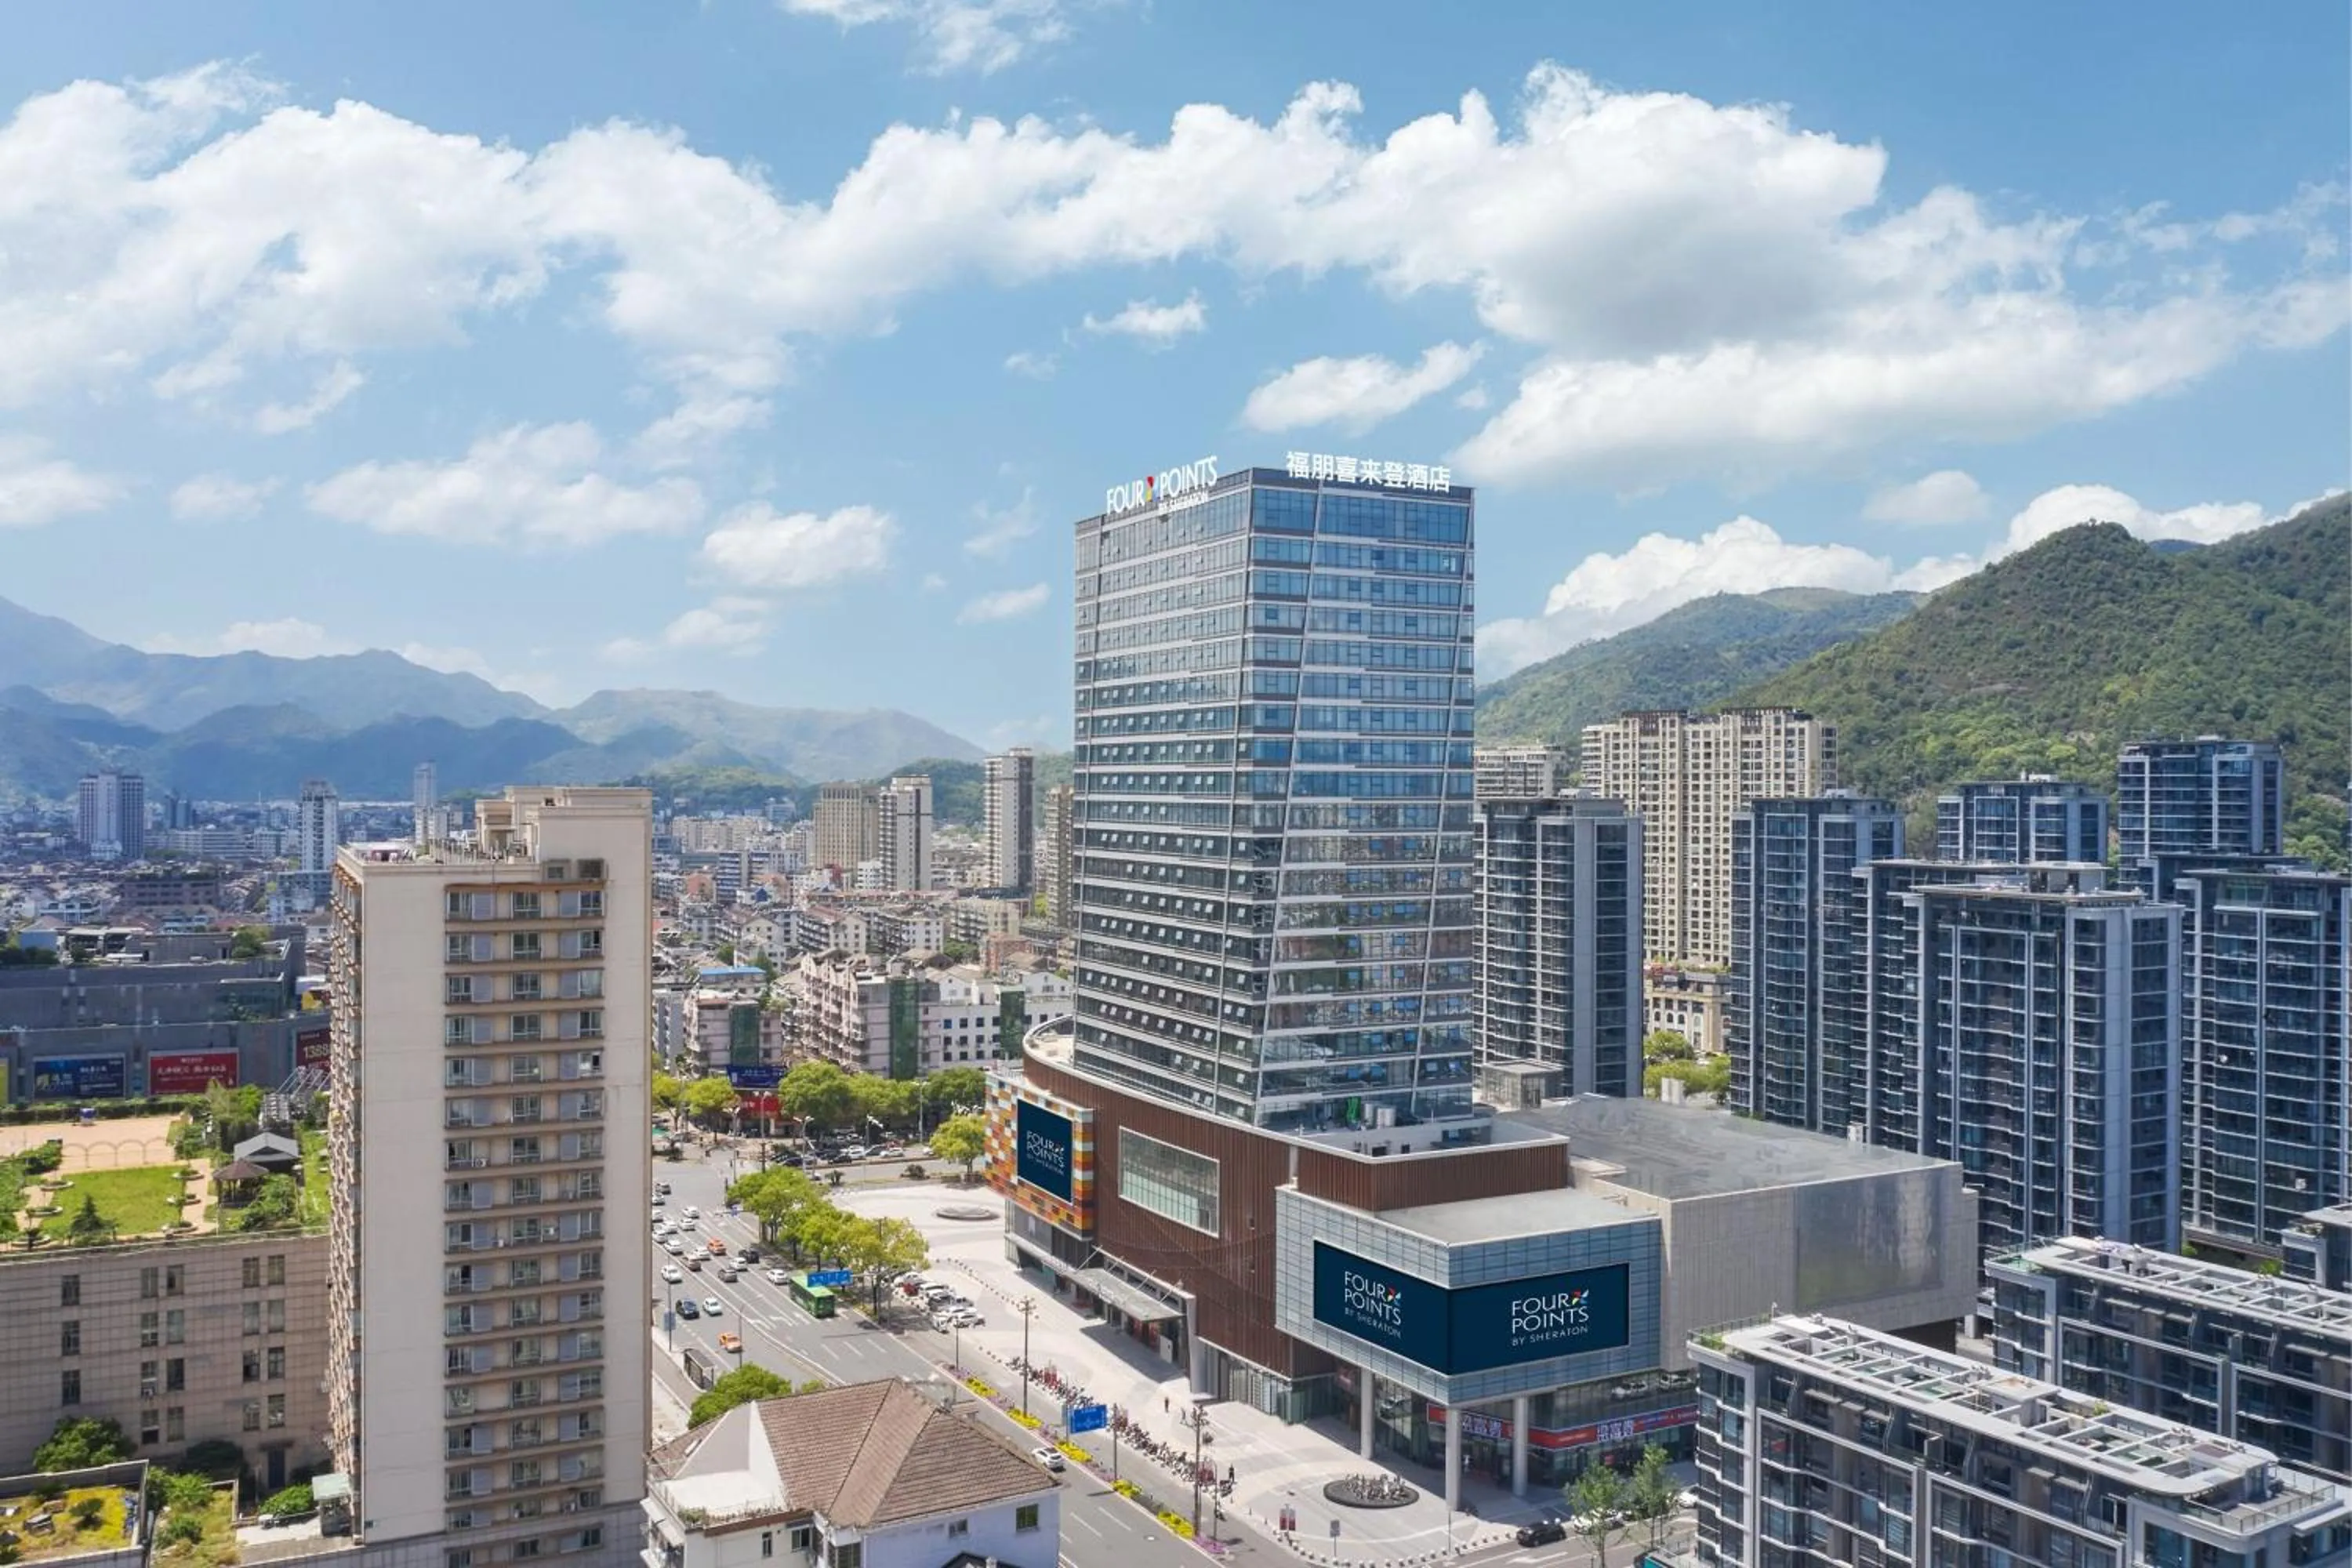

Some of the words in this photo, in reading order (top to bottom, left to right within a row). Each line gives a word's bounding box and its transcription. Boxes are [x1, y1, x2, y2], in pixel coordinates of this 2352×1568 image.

[1106, 479, 1145, 514] FOUR
[1160, 455, 1218, 500] POINTS
[1286, 451, 1450, 493] 福朋喜来登酒店
[1027, 1130, 1054, 1151] FOUR
[1027, 1141, 1065, 1168] POINTS
[1345, 1271, 1387, 1302] FOUR
[1345, 1287, 1402, 1326] POINTS
[1512, 1293, 1570, 1316] FOUR
[1512, 1305, 1589, 1334] POINTS
[1512, 1336, 1525, 1346] BY
[1530, 1326, 1588, 1343] SHERATON
